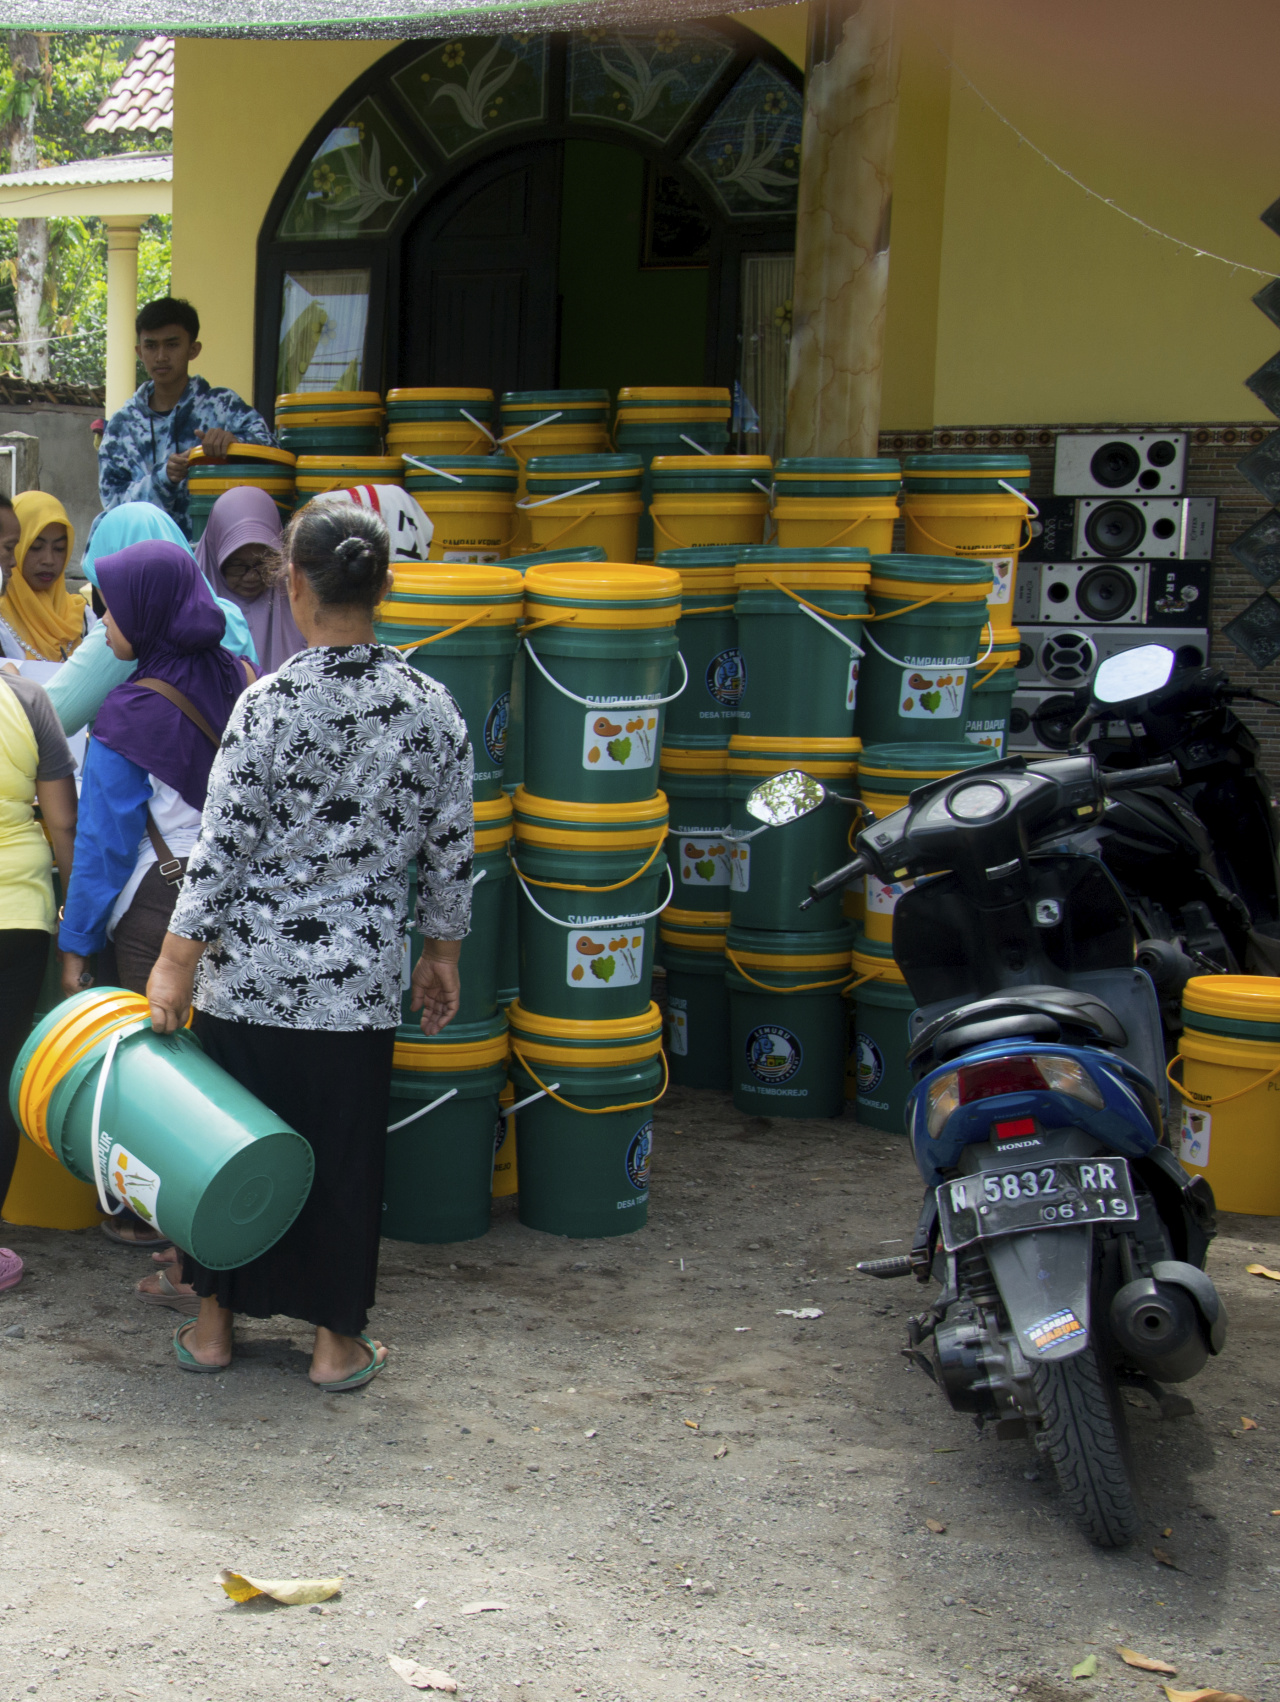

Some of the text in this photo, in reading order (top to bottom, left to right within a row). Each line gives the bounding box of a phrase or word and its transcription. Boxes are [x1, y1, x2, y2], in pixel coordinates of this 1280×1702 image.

[984, 719, 1006, 731] DAPUR
[757, 1086, 809, 1097] TEMBOKREJO
[997, 1139, 1041, 1152] HONDA
[98, 1131, 114, 1175] DAPUR
[950, 1163, 1118, 1213] N 5832 RR
